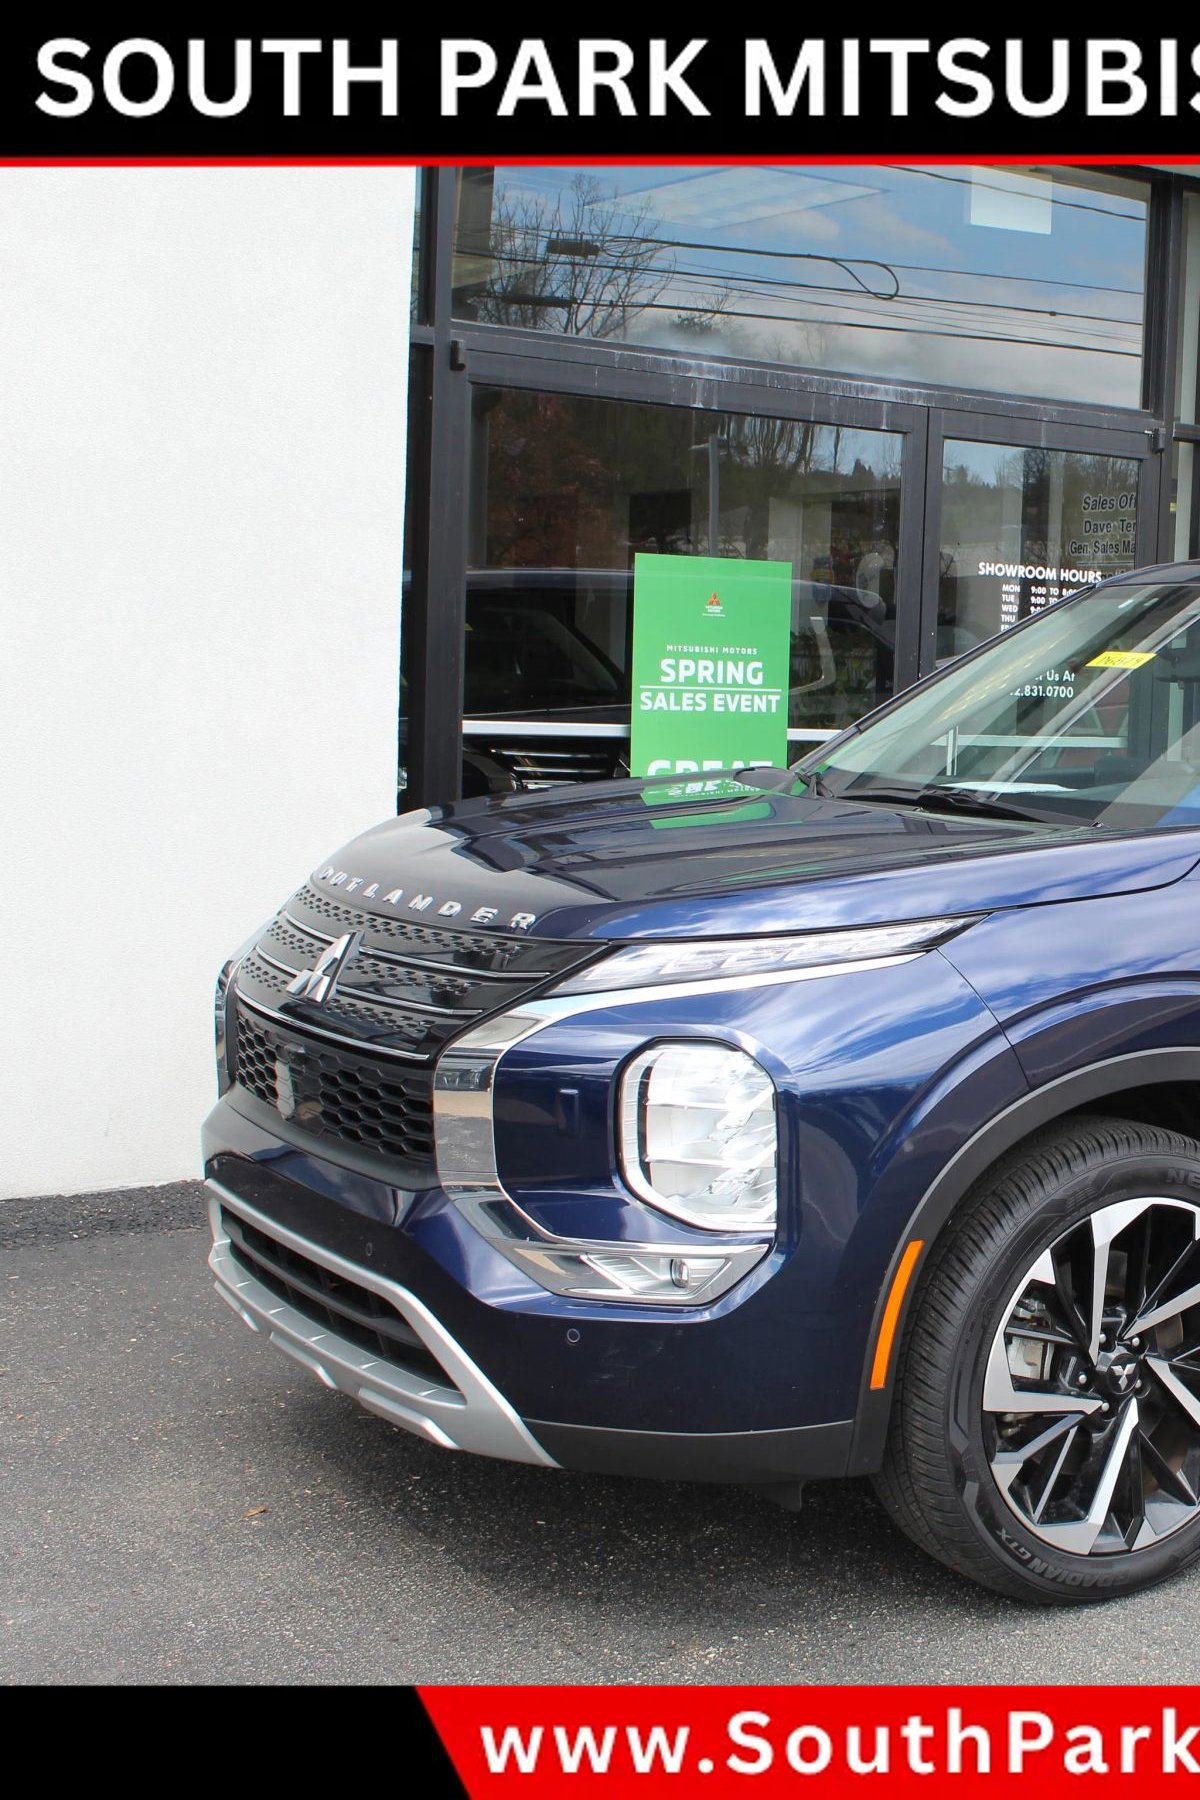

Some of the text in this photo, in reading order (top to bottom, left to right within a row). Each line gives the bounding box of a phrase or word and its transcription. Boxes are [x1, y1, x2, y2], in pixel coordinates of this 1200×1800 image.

[1082, 494, 1115, 511] Sales
[1084, 520, 1112, 534] Dave
[1070, 541, 1091, 554] Gen.
[1093, 541, 1120, 554] Sales
[978, 562, 1057, 581] SHOWROOM
[1060, 568, 1102, 583] HOURS
[1002, 584, 1020, 593] MON
[1030, 586, 1047, 594] 9:00
[1049, 587, 1059, 595] TO
[1002, 594, 1015, 602] TUE
[1030, 596, 1046, 604] 9:00
[1001, 604, 1018, 612] WED
[1001, 614, 1016, 623] THU
[666, 644, 758, 656] MITSUBISHI MOTORS
[660, 658, 764, 685] SPRING
[1046, 669, 1060, 681] Us
[1062, 670, 1075, 682] At
[640, 691, 781, 713] SALES EVENT
[317, 866, 537, 930] OUTLANDER
